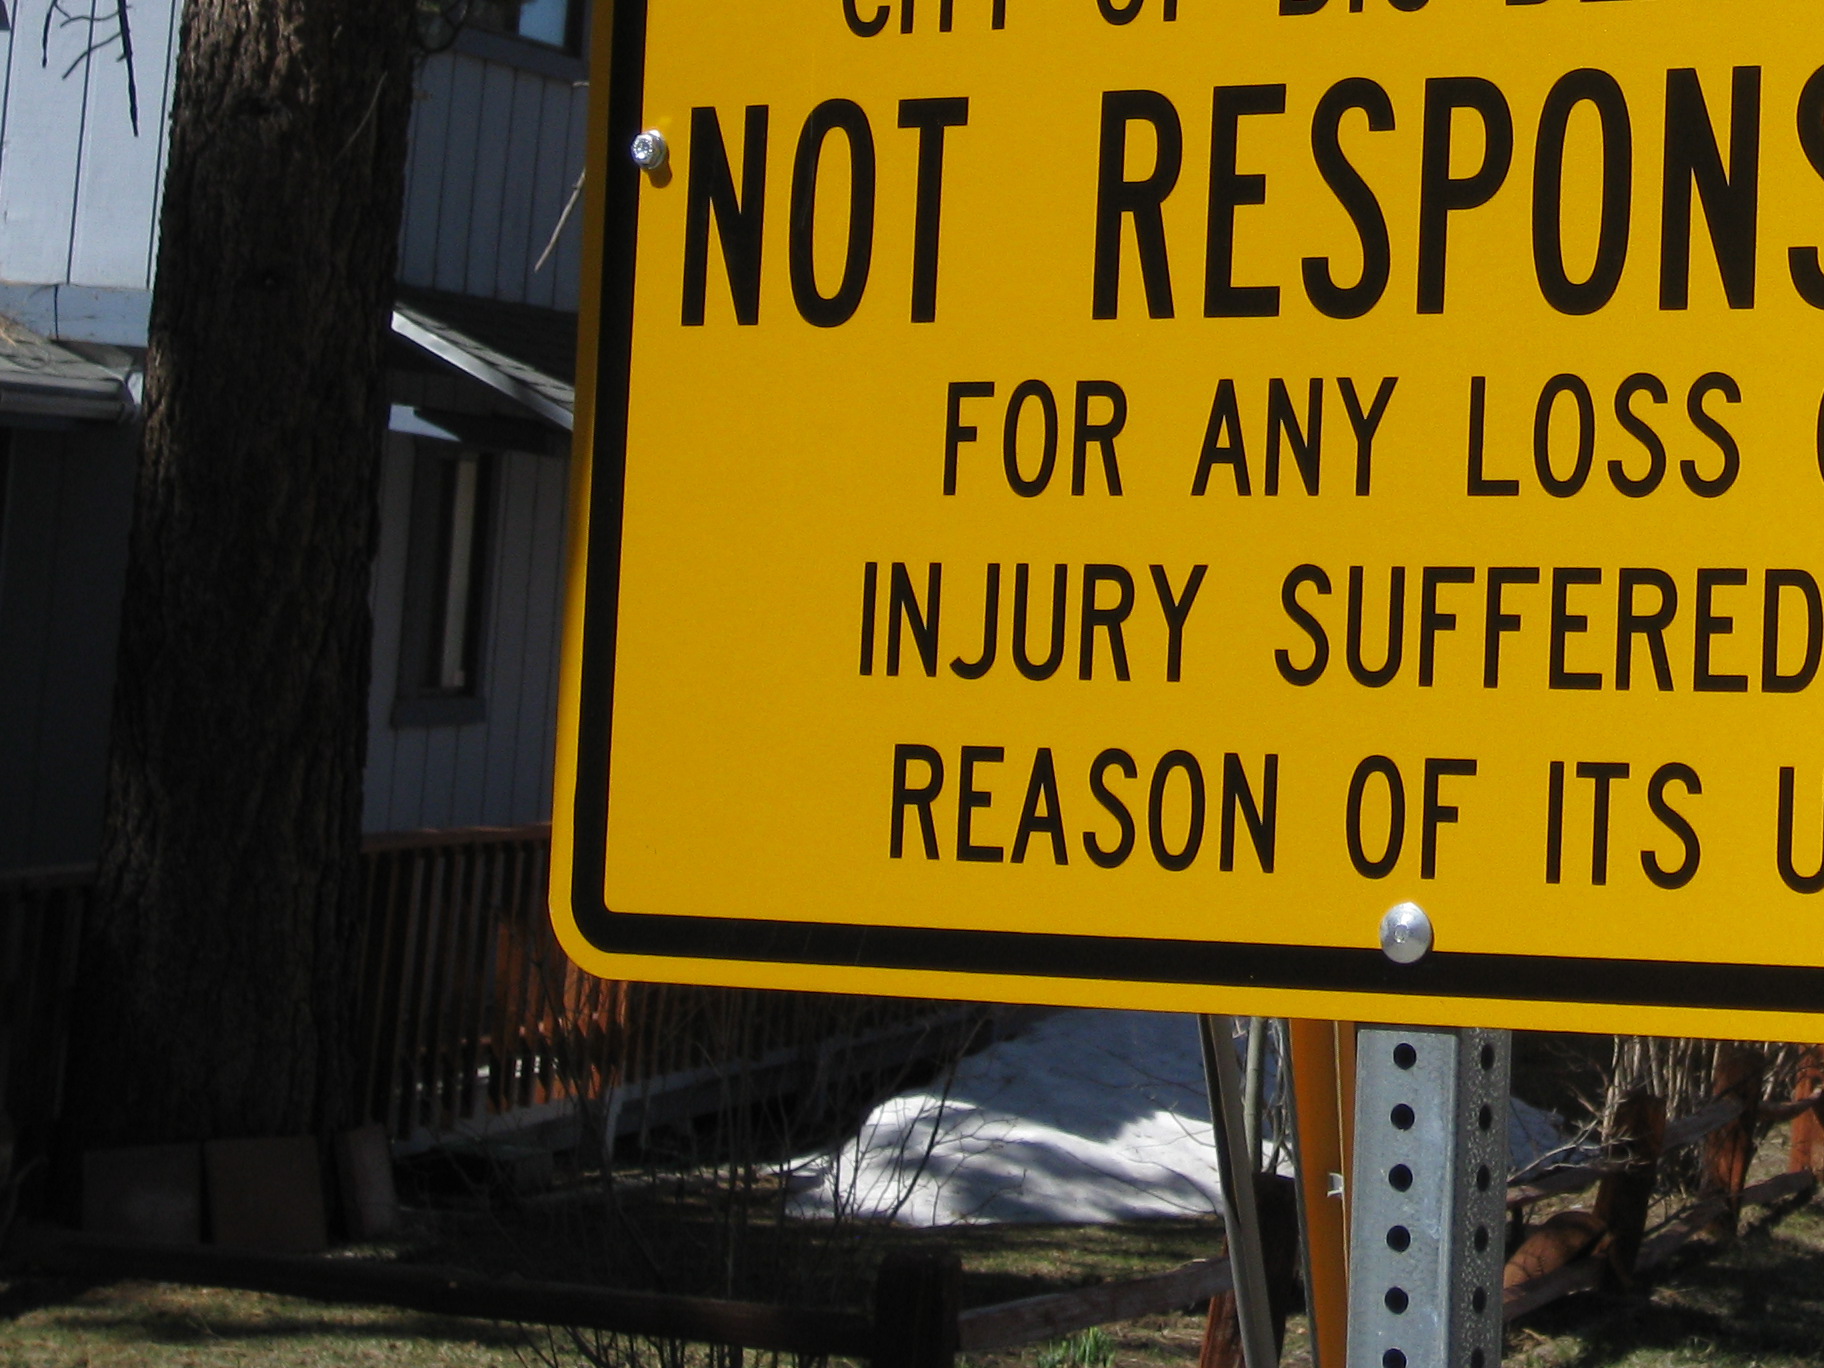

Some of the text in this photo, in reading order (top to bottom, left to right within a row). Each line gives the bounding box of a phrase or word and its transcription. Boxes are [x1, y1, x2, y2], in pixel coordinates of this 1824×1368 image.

[682, 97, 968, 327] NOT
[944, 380, 1127, 497] FOR
[1192, 377, 1398, 496] ANY
[1468, 373, 1741, 498] LOSS
[860, 562, 1208, 682] INJURY
[1275, 564, 1823, 693] SUFFERED
[890, 744, 1278, 873] REASON
[1346, 755, 1477, 879] OF
[1546, 762, 1701, 889] ITS
